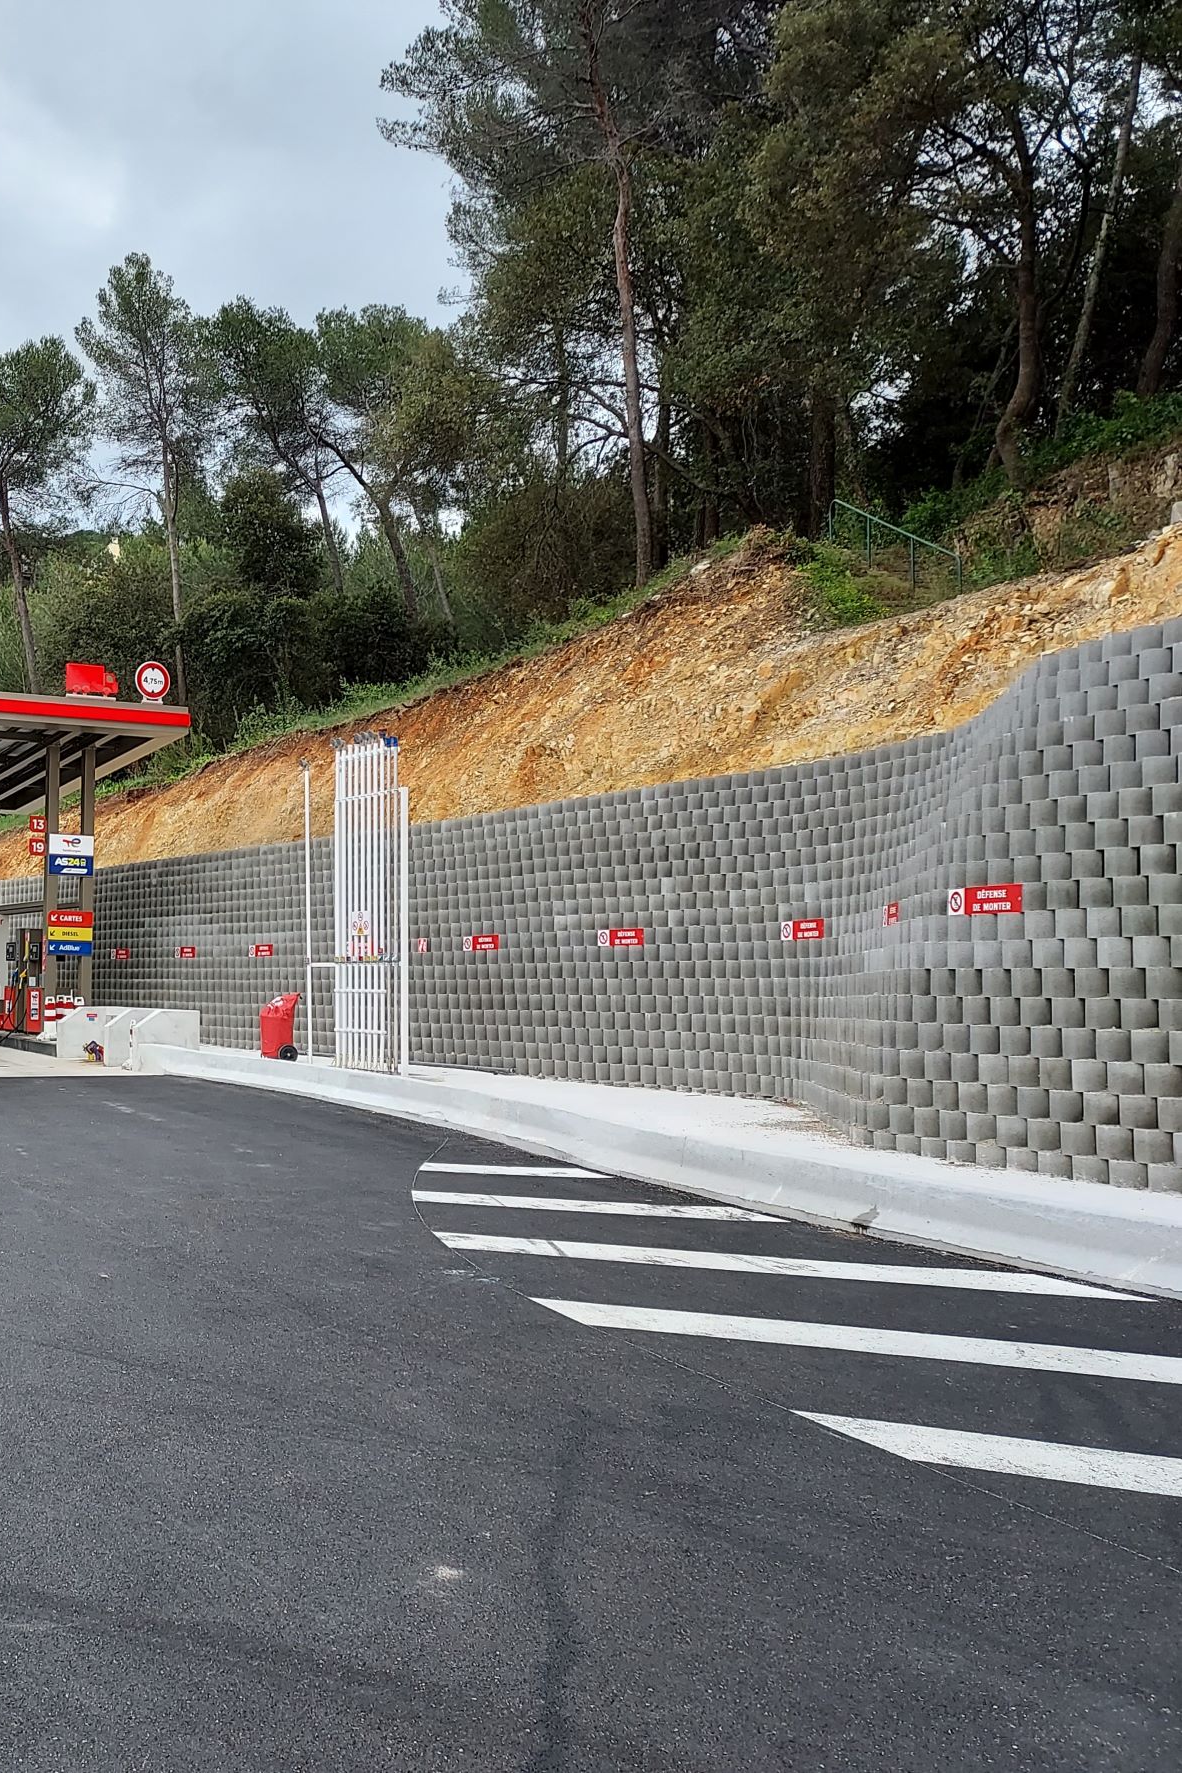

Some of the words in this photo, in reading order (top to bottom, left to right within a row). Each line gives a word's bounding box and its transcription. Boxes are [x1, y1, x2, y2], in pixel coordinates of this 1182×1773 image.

[32, 819, 44, 830] 13
[31, 841, 45, 853] 19
[54, 857, 80, 867] AS24
[976, 889, 1007, 899] DÉFENSE
[972, 903, 981, 912] DE
[983, 902, 1011, 911] MONTER
[59, 914, 83, 922] CARTES
